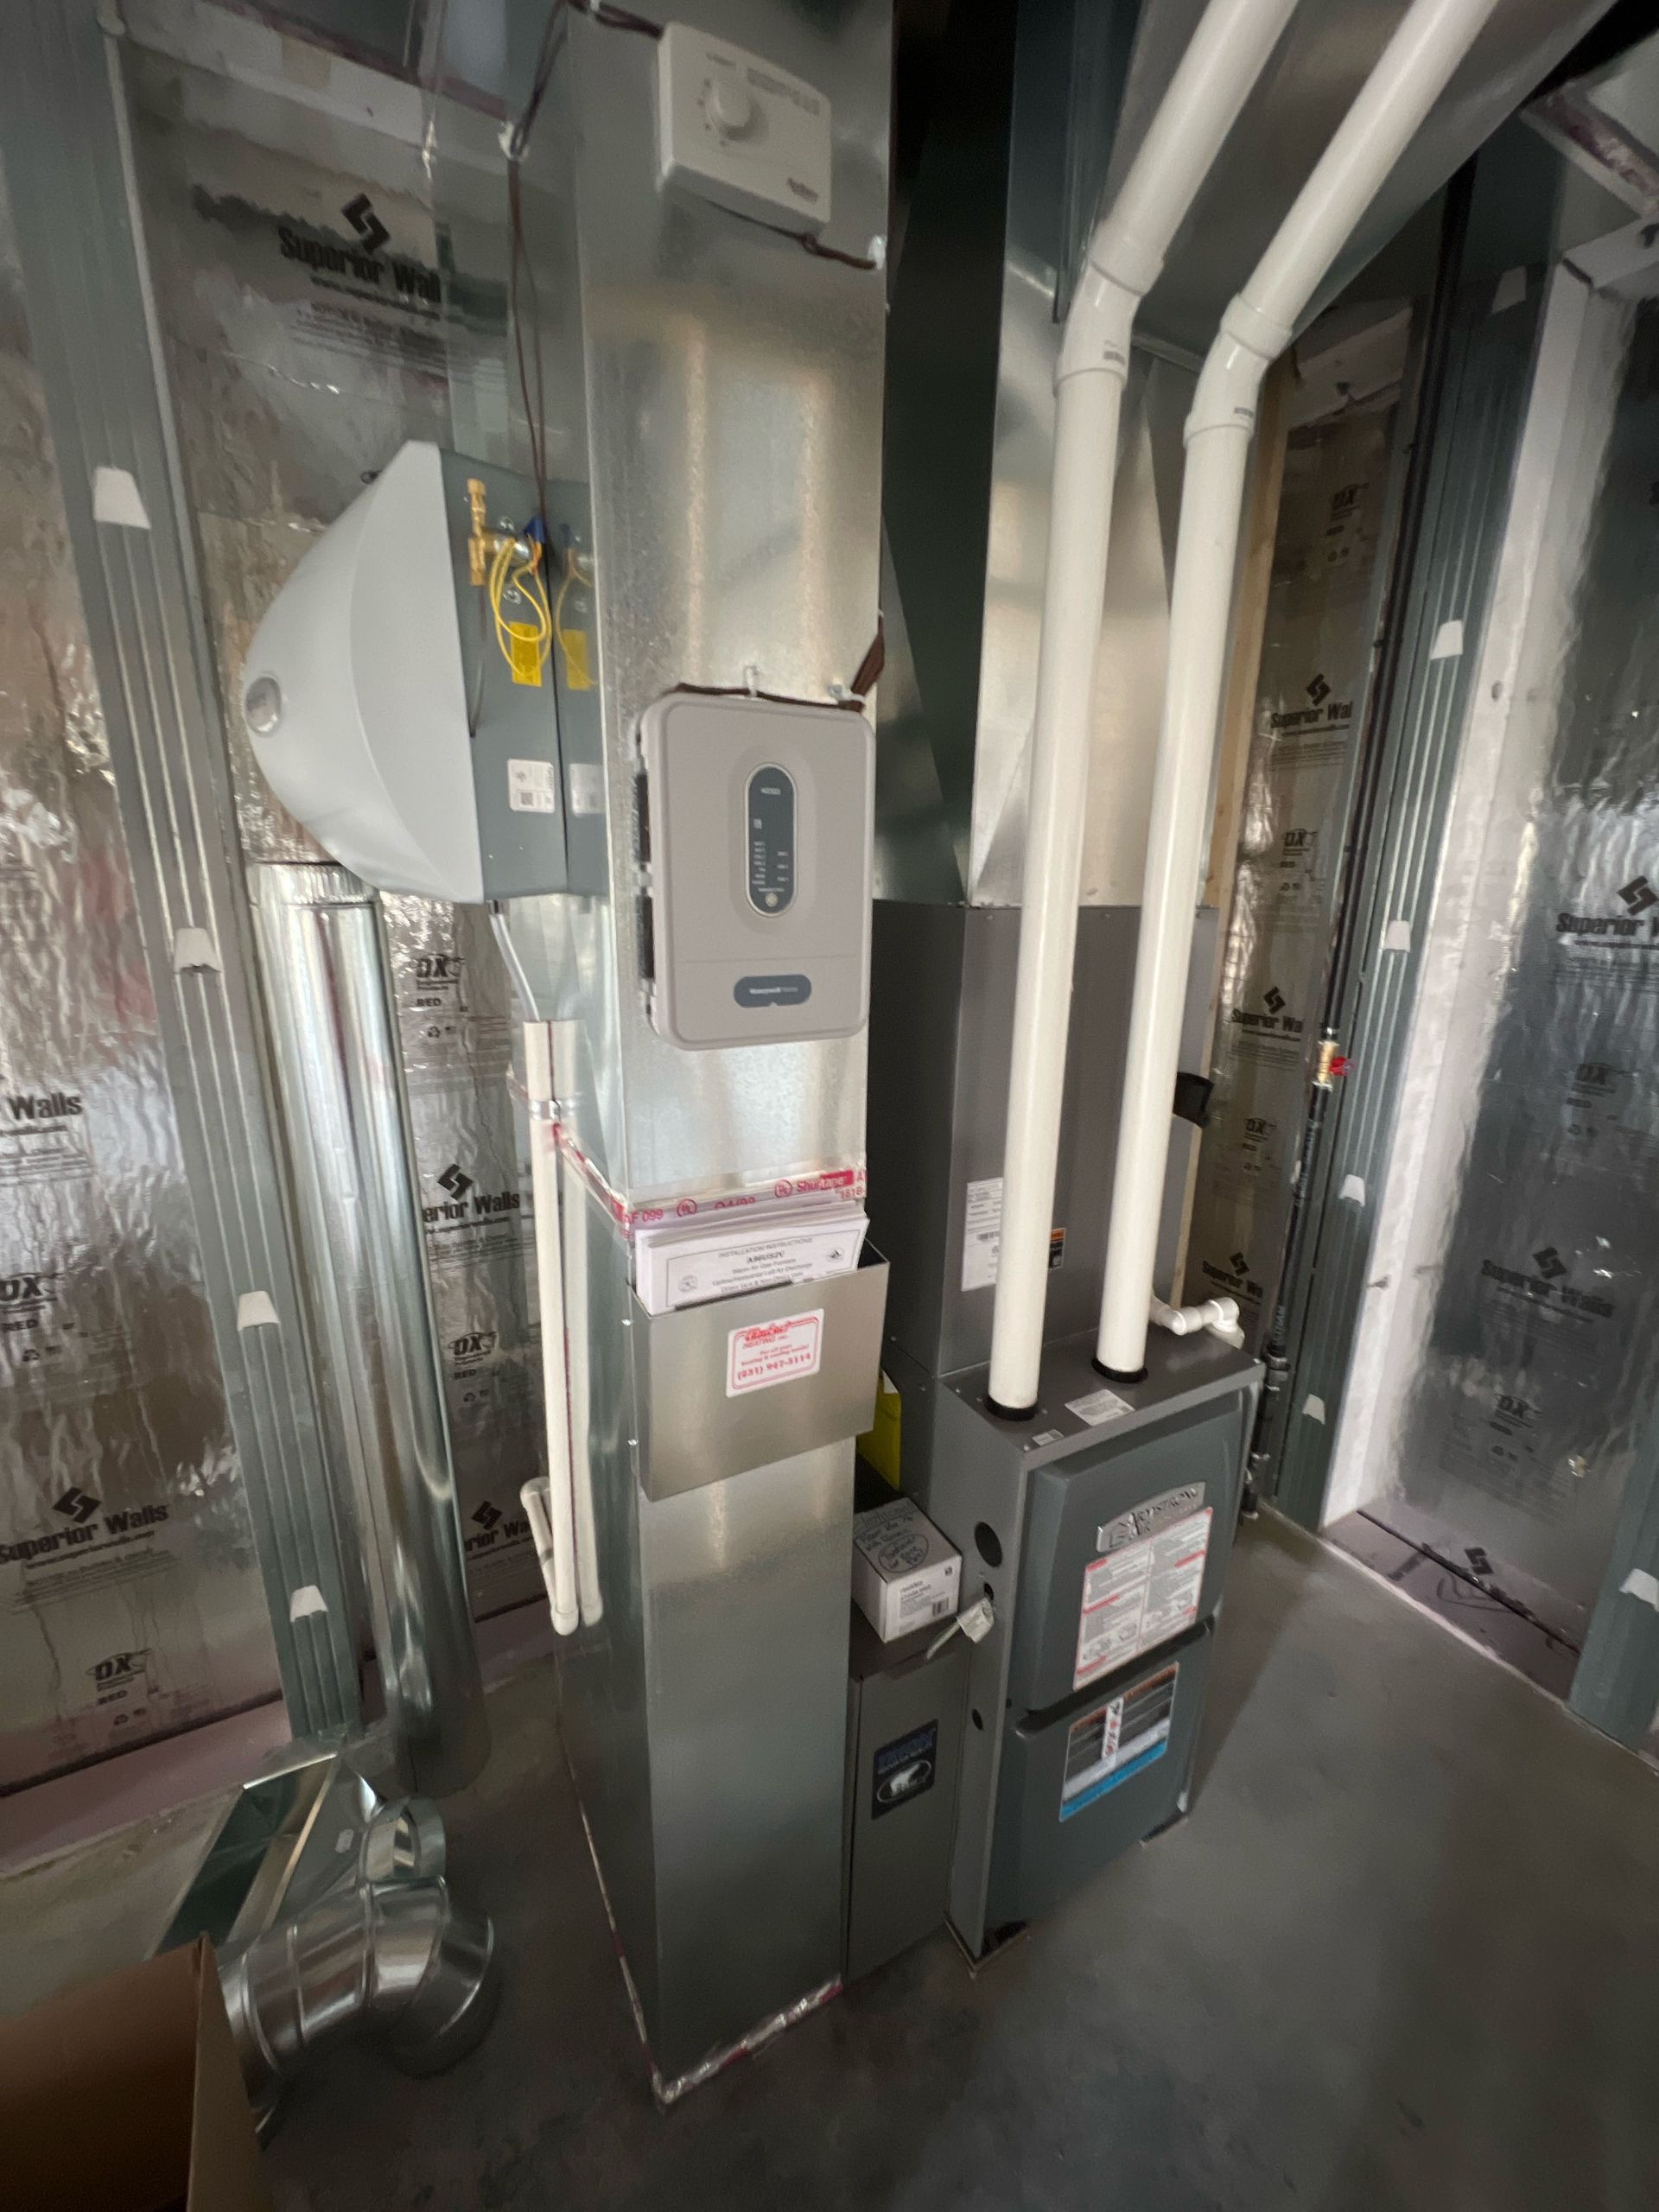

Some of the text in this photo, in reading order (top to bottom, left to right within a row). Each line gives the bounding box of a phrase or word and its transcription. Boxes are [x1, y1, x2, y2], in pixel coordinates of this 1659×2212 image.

[1557, 913, 1645, 937] Superior
[7, 1091, 83, 1120] Walls
[797, 1175, 846, 1193] Shurtape
[473, 1191, 520, 1215] Walls
[104, 1505, 169, 1535] Walls
